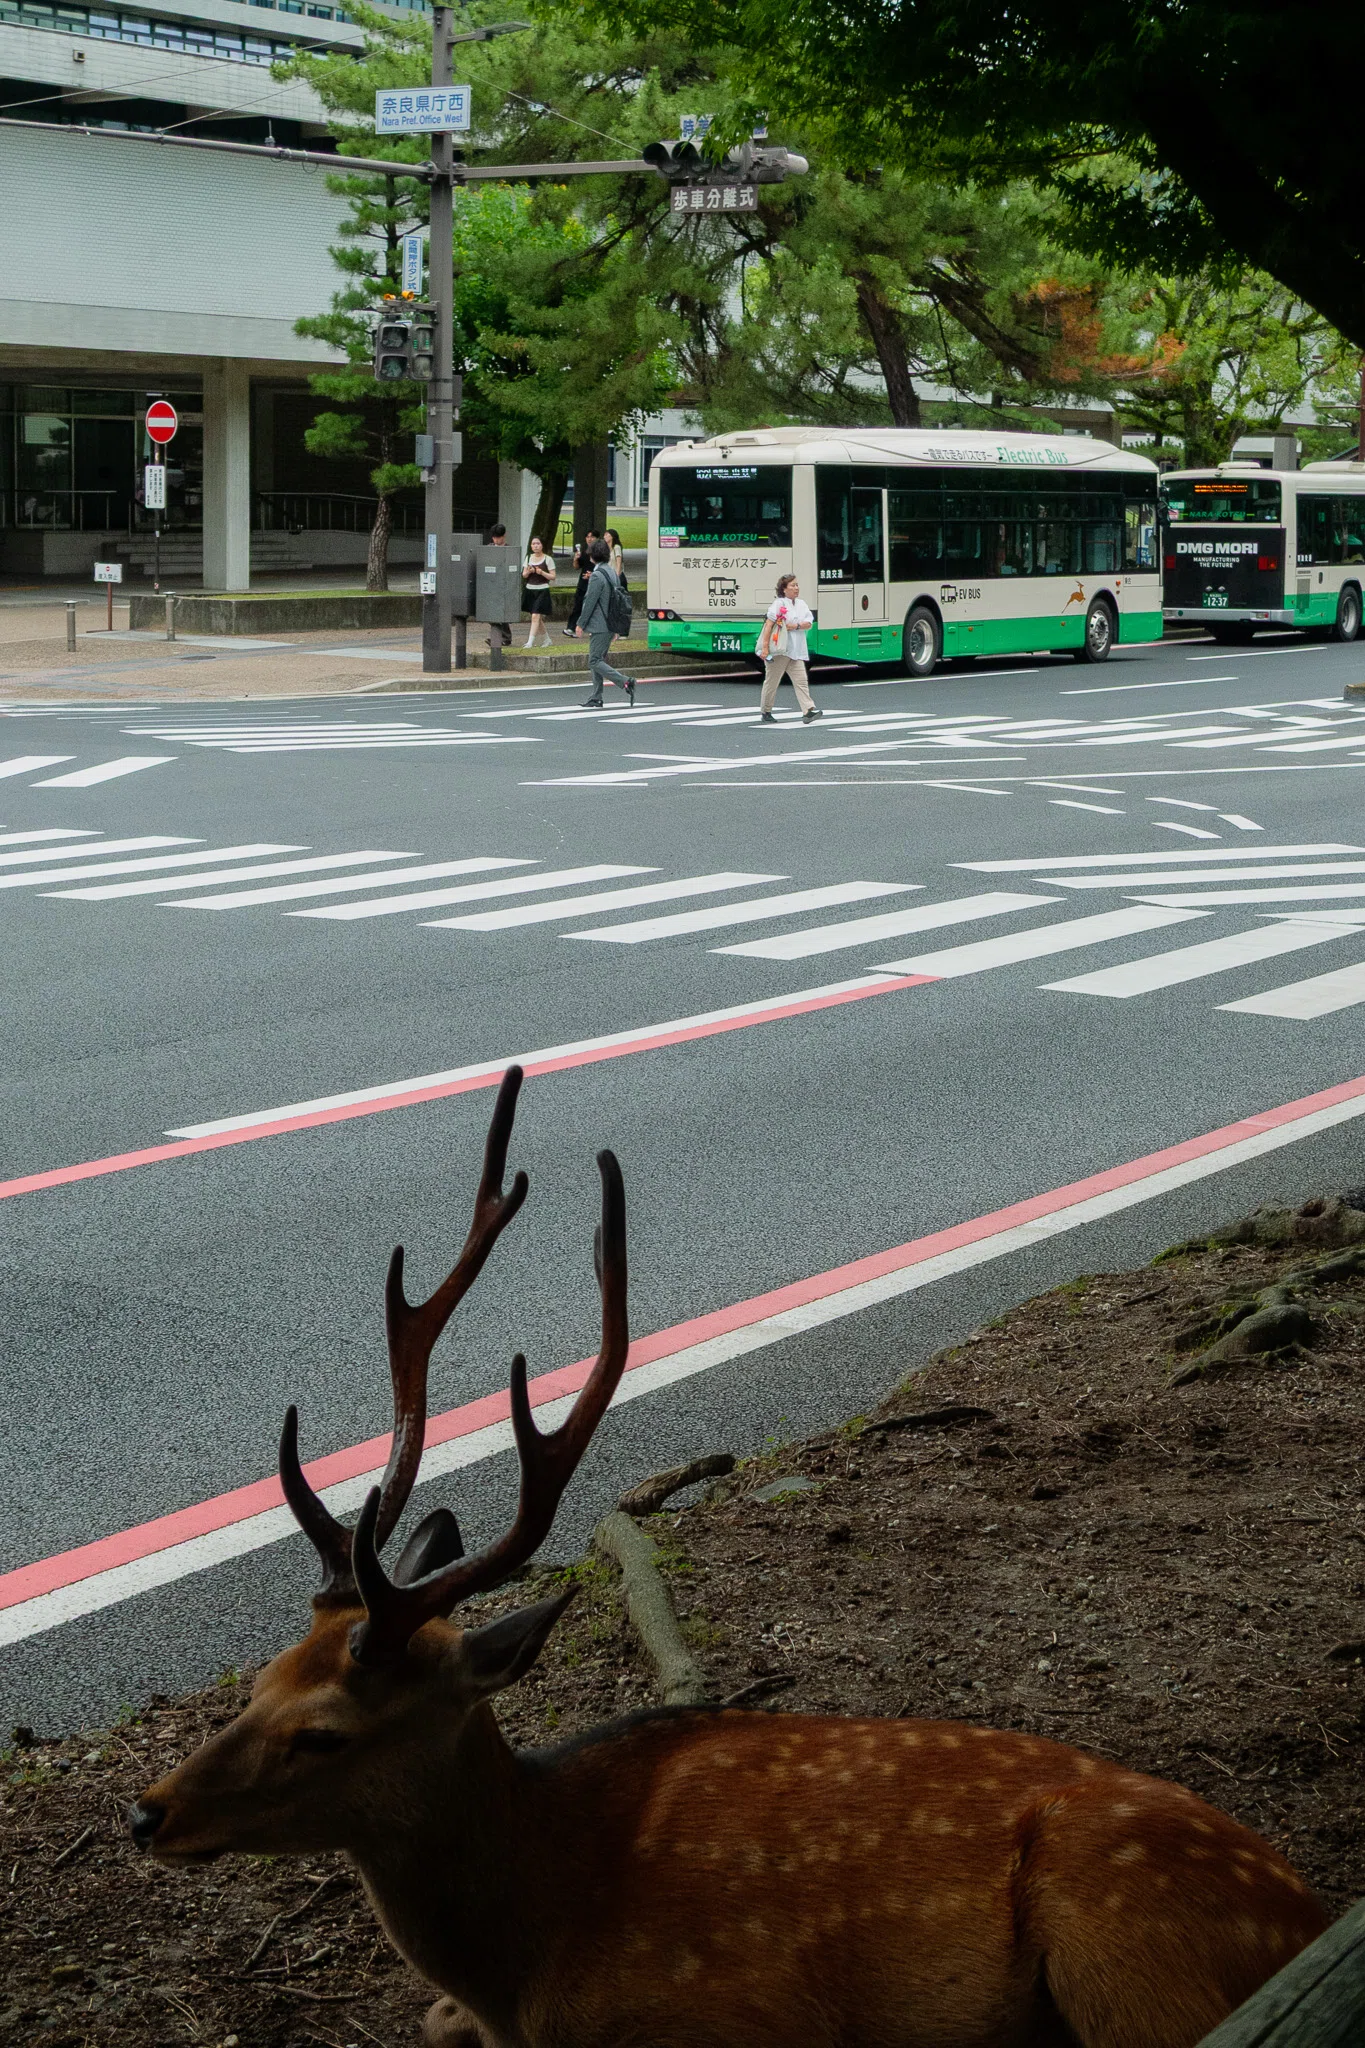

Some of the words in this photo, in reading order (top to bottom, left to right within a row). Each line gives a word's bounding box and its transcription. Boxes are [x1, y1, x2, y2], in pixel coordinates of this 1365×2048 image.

[382, 93, 464, 115] 奈良県庁西
[382, 117, 399, 127] Nara
[444, 113, 463, 123] West
[674, 186, 754, 211] 歩車分離式
[996, 446, 1045, 464] Electric
[1045, 448, 1069, 464] Bus
[689, 533, 719, 542] NARA
[721, 533, 758, 542] KOTSU
[1176, 542, 1215, 554] DMG
[1215, 542, 1258, 554] MORI
[959, 588, 967, 600] EV
[968, 587, 981, 600] BUS
[708, 598, 719, 607] EV
[720, 598, 737, 607] BUS
